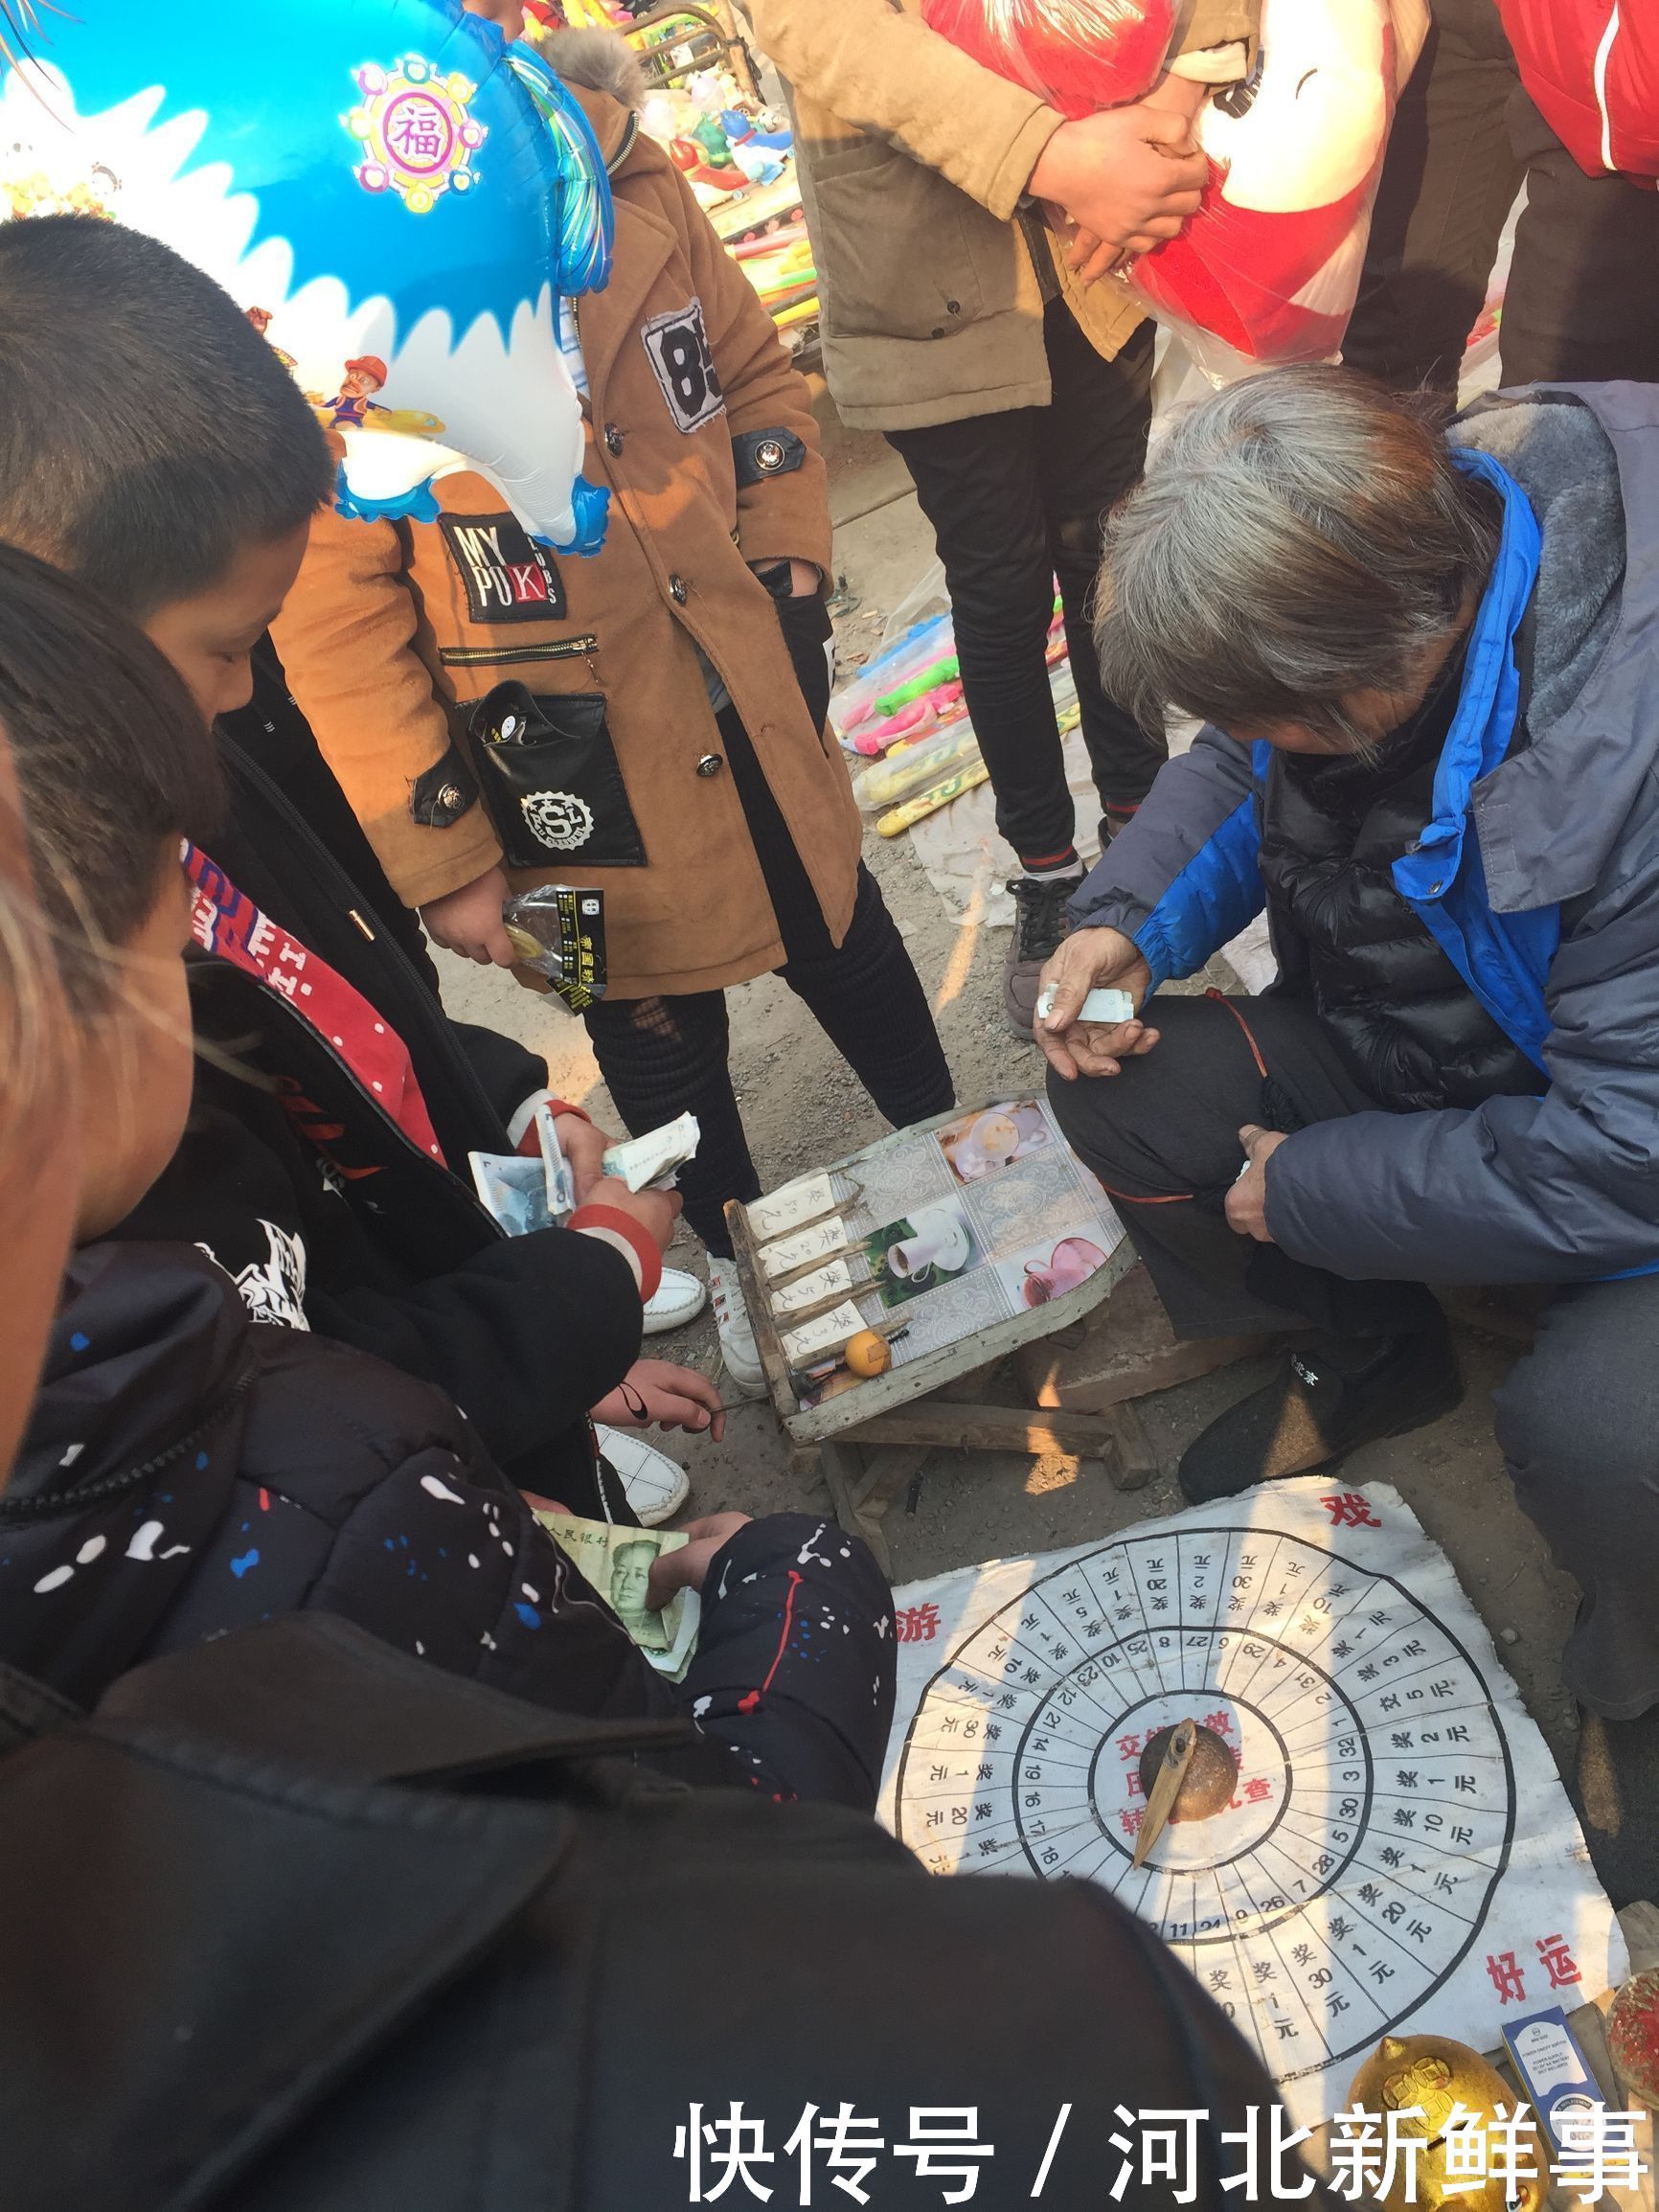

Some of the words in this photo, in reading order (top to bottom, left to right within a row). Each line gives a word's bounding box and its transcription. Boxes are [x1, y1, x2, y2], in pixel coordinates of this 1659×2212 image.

[393, 106, 441, 157] 福
[453, 526, 507, 567] MY
[1319, 1493, 1381, 1527] 戏
[549, 1527, 609, 1548] 人民银行
[895, 1603, 942, 1642] 游
[1126, 1639, 1148, 1655] 25
[1159, 1636, 1170, 1648] 8
[1186, 1636, 1209, 1647] 27
[1217, 1636, 1230, 1650] 6
[1242, 1642, 1265, 1658] 29
[1102, 1652, 1122, 1668] 10
[1273, 1658, 1286, 1669] 4
[1294, 1672, 1316, 1689] 31
[1057, 1688, 1078, 1705] 12
[1315, 1692, 1332, 1705] 2
[1042, 1711, 1061, 1730] 21
[1331, 1718, 1347, 1726] 1
[1032, 1738, 1050, 1752] 14
[1337, 1736, 1356, 1757] 32
[1024, 1765, 1041, 1780] 19
[1342, 1770, 1360, 1781] 3
[1024, 1791, 1041, 1807] 16
[1339, 1797, 1359, 1818] 30
[1331, 1830, 1349, 1844] 5
[1040, 1846, 1059, 1865] 18
[1311, 1854, 1335, 1876] 28
[1293, 1880, 1307, 1894] 7
[1260, 1895, 1285, 1913] 26
[1236, 1909, 1248, 1924] 9
[1170, 1923, 1187, 1938] 11
[1486, 1933, 1582, 2006] 好运
